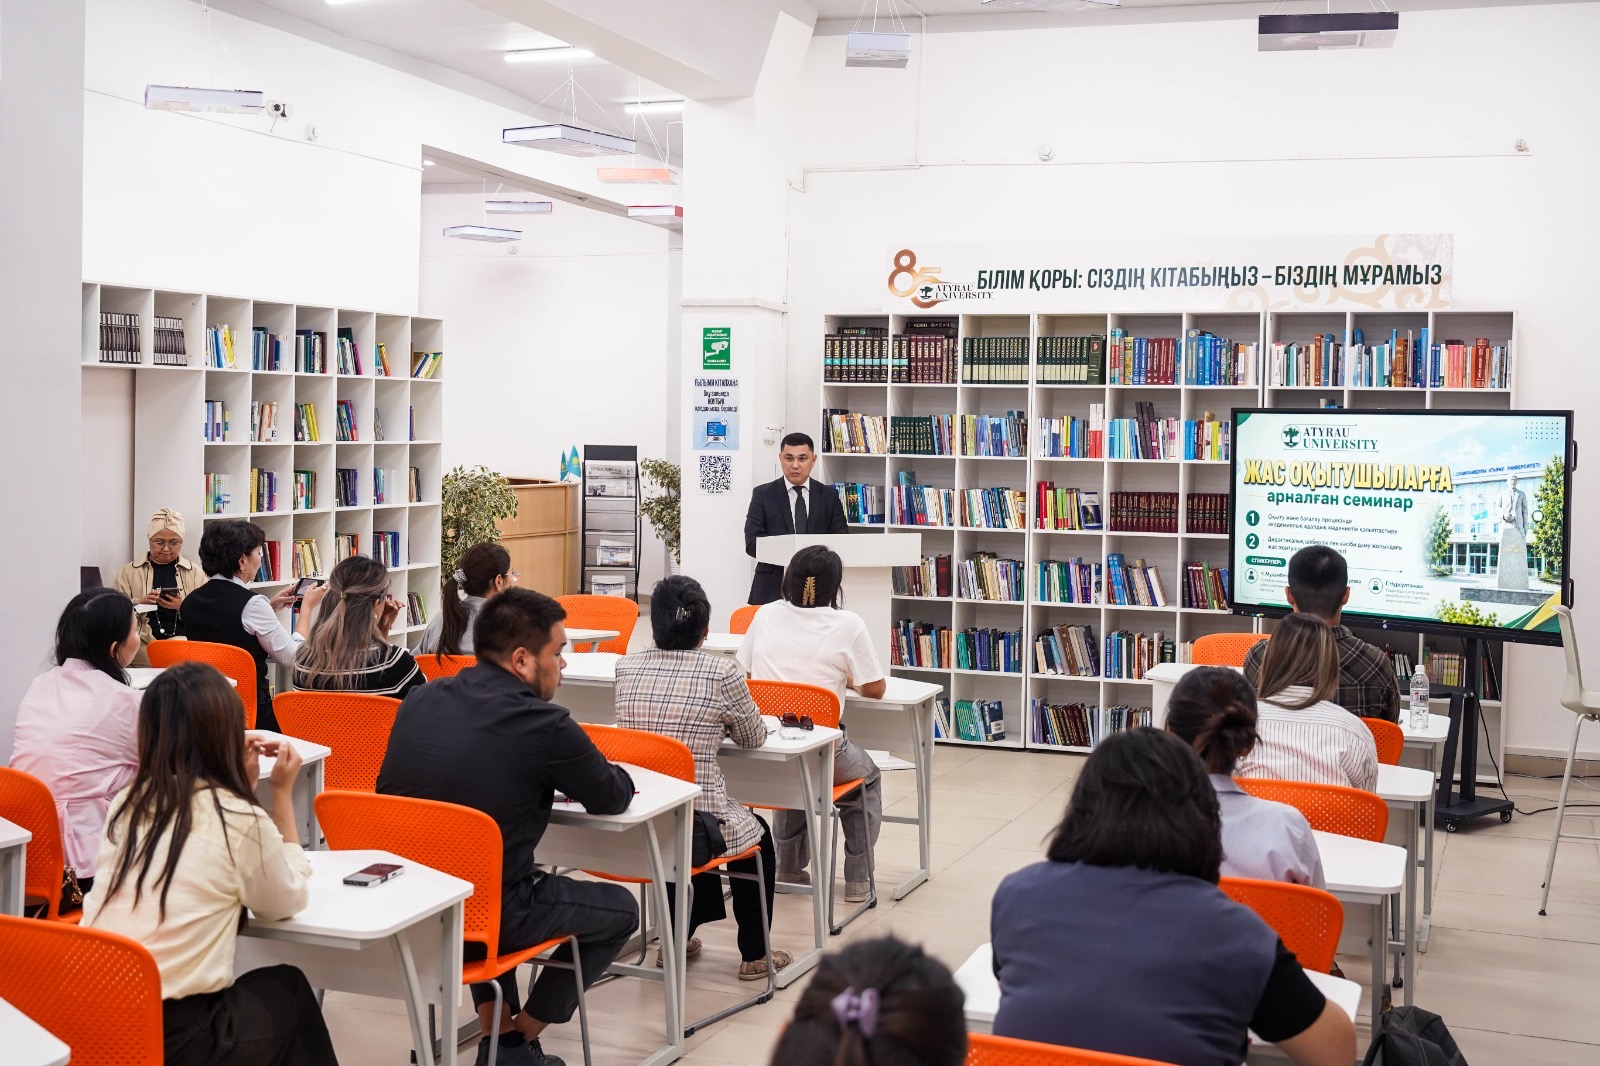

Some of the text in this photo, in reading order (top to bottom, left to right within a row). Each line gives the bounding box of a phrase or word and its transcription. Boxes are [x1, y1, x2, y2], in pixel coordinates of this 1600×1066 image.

[977, 269, 1025, 290] БІЛІМ
[1029, 268, 1083, 291] ҚОРЫ:
[1087, 267, 1145, 291] СІЗДІҢ
[1150, 265, 1259, 289] КІТАБЫҢЫЗ
[1275, 265, 1337, 288] БІЗДІҢ
[1343, 264, 1442, 286] МҰРАМЫЗ
[935, 284, 974, 292] ATYRAU
[935, 291, 994, 300] UNIVERSITY
[1303, 426, 1350, 438] ATYRAU
[1303, 439, 1379, 450] UNIVERSITY
[1244, 459, 1454, 493] ЖАС ОҚЫТУШЫЛАРҒА
[1267, 490, 1414, 512] арналған семинар
[1249, 513, 1255, 524] 1
[1248, 535, 1256, 548] 2
